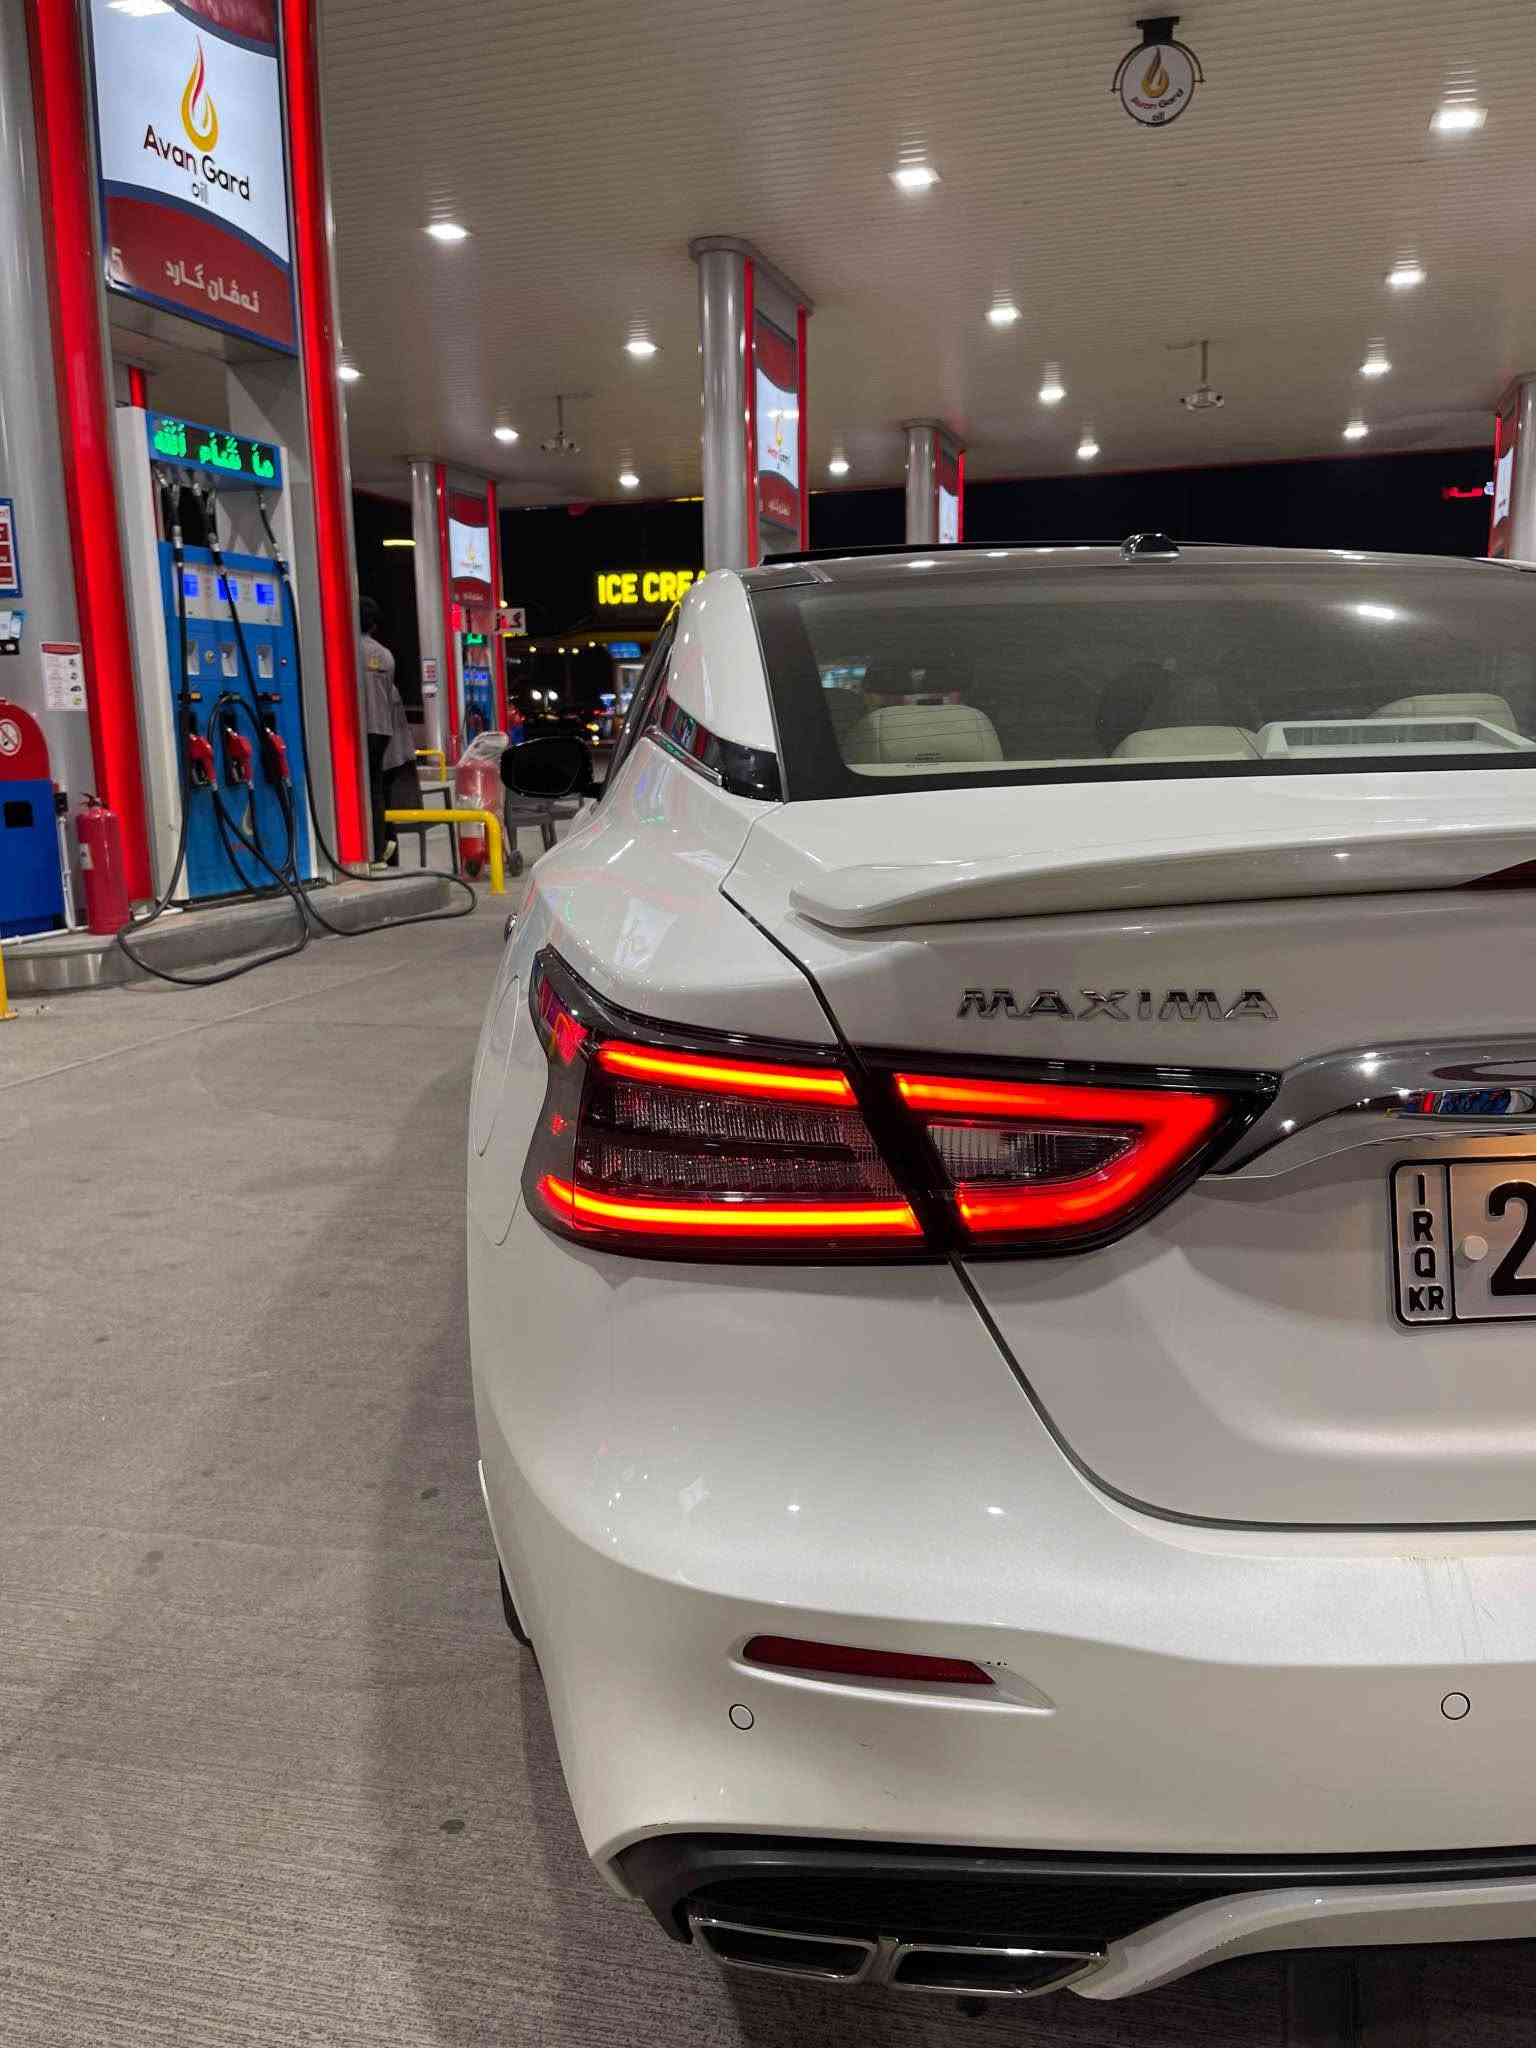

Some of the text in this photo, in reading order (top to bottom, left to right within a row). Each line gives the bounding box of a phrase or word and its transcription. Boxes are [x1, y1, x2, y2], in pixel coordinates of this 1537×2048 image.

[143, 123, 250, 201] Avan Gard
[191, 182, 208, 204] oil
[597, 573, 639, 605] ICE
[957, 987, 1280, 1021] MAXIMA
[1488, 1181, 1536, 1296] 2
[1408, 1285, 1445, 1312] KR
